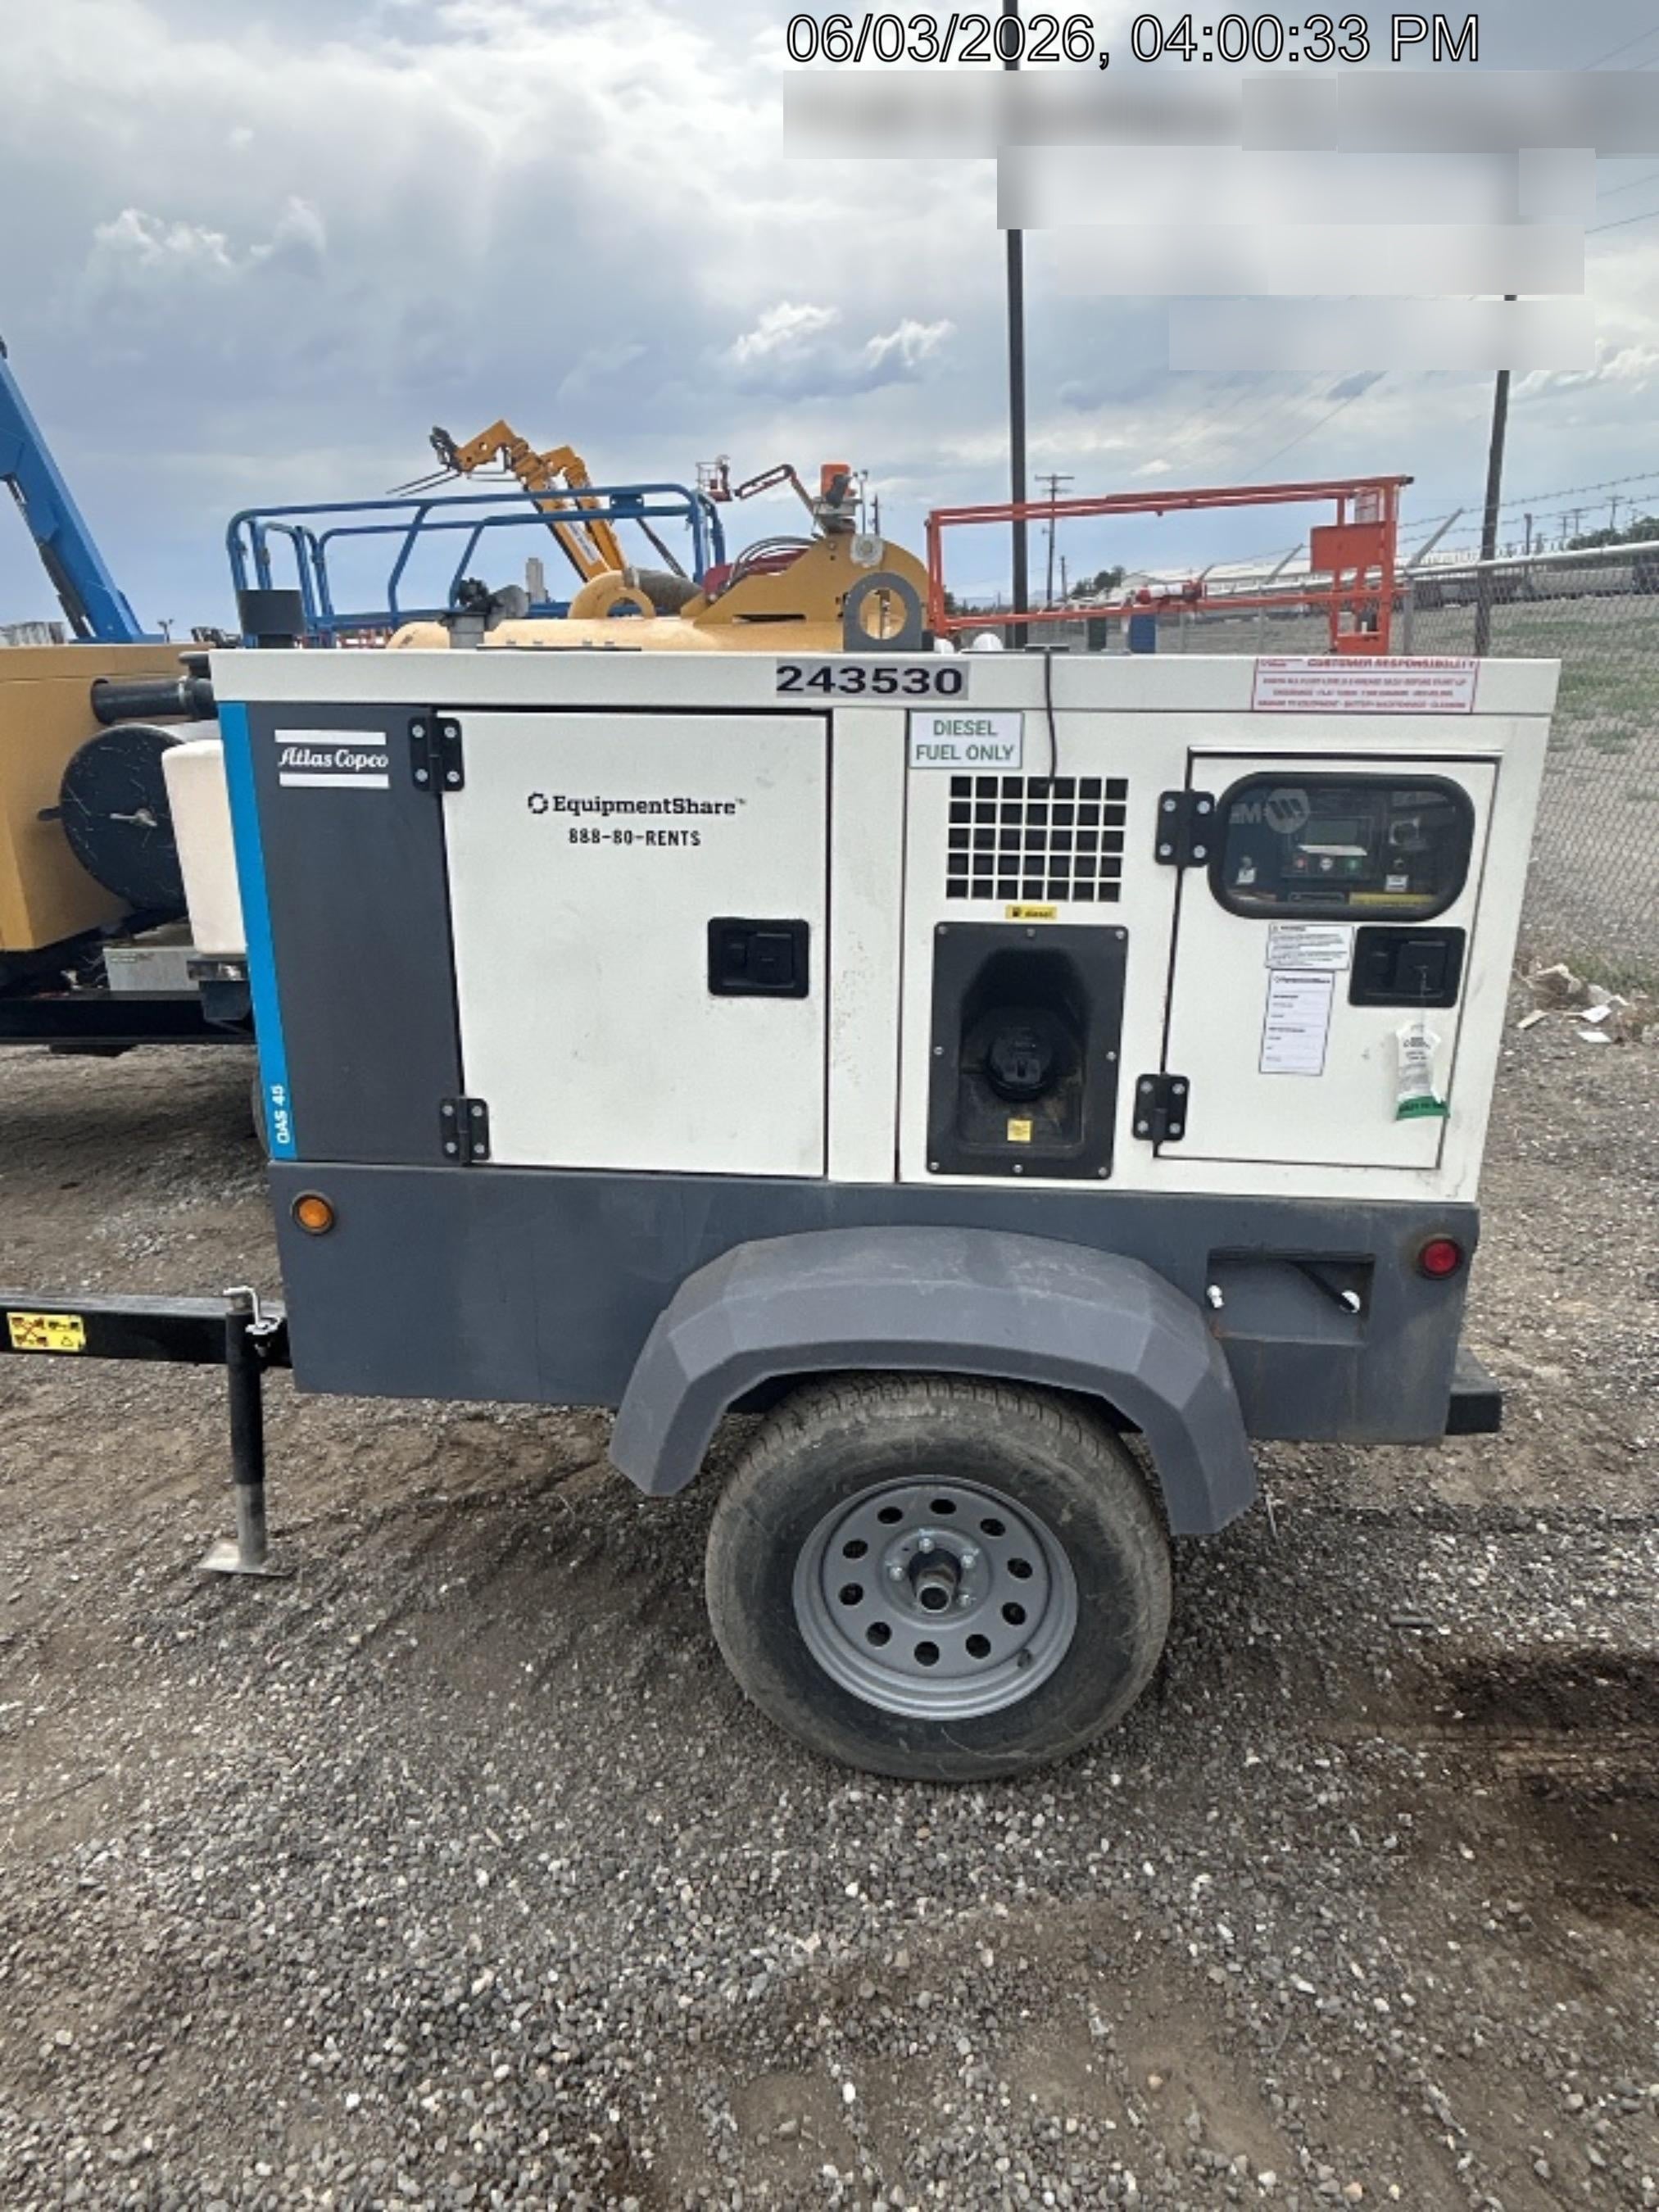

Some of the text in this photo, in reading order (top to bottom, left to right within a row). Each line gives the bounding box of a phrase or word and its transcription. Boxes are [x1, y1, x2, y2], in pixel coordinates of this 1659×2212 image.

[776, 665, 962, 695] 243530
[933, 719, 997, 737] DIESEL
[279, 746, 389, 772] Atlas Copco
[915, 745, 1014, 761] FUEL ONLY
[552, 796, 737, 816] EquipmentShare
[569, 828, 701, 846] 888-80-RENTS
